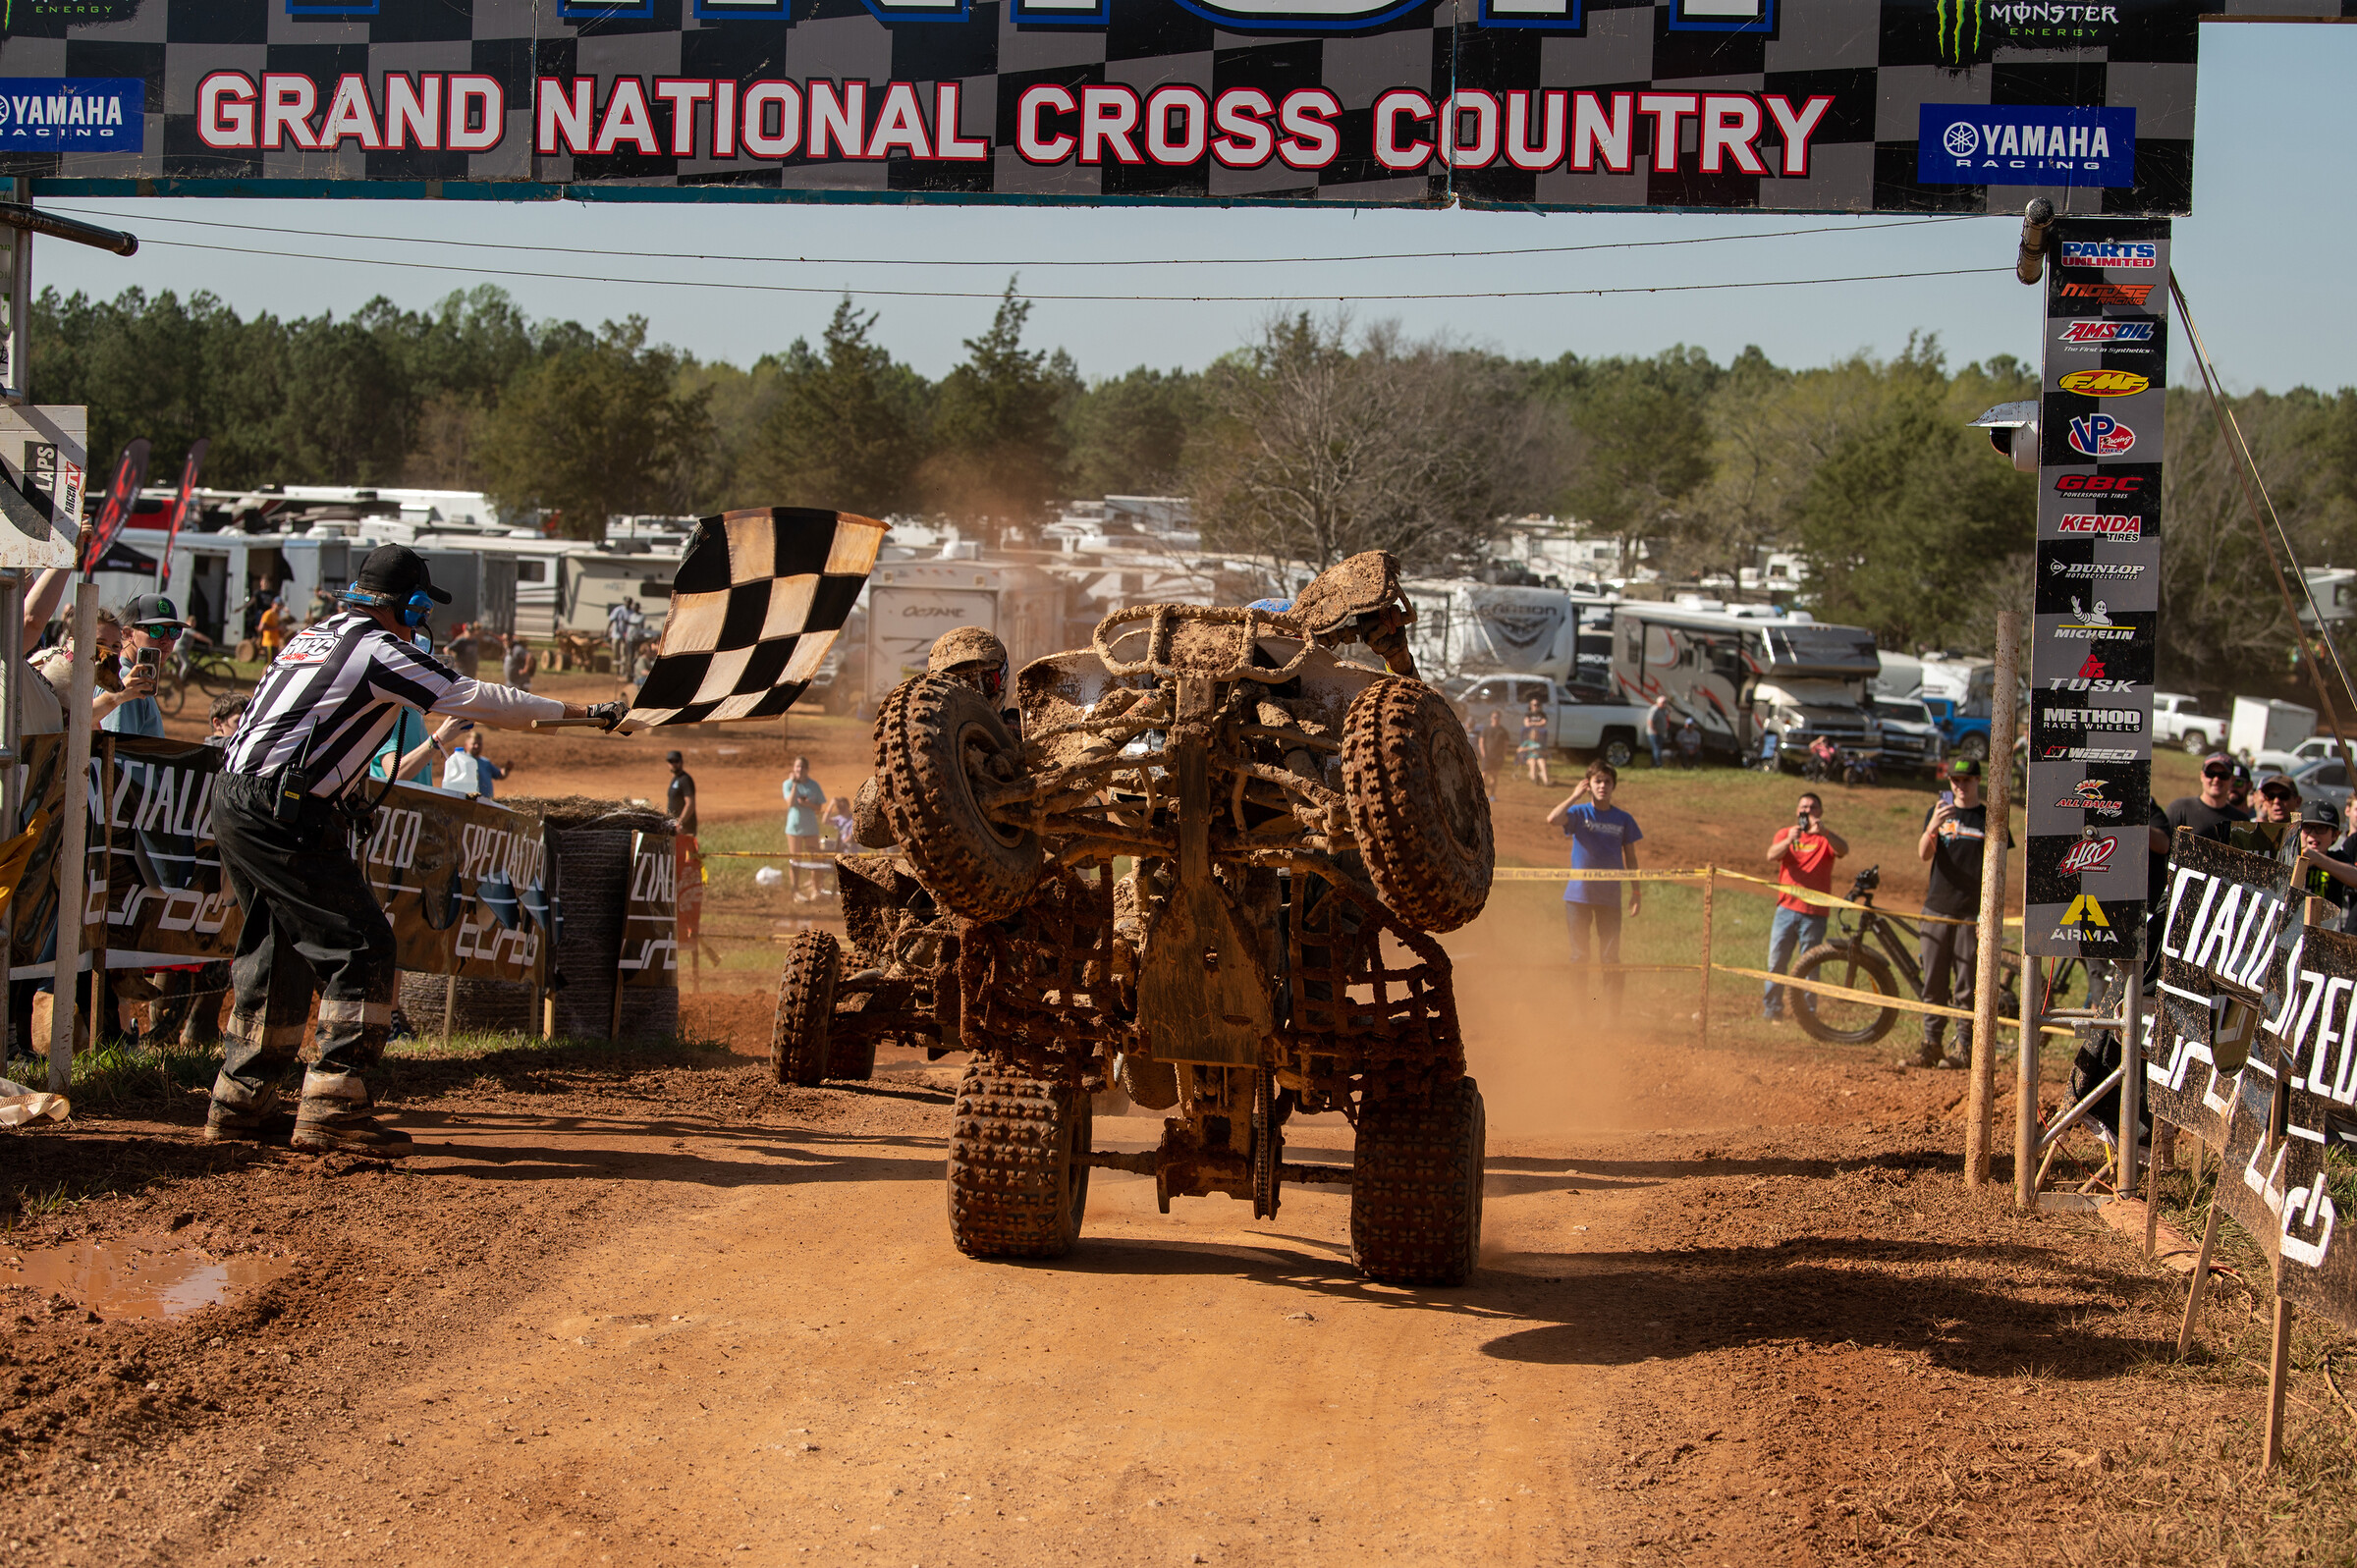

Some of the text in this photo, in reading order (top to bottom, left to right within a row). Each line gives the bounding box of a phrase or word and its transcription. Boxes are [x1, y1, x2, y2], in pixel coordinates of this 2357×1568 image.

[1990, 2, 2118, 25] MONSTER
[2009, 27, 2099, 37] ENERGY
[12, 95, 123, 126] YAMAHA
[197, 72, 1836, 177] GRAND NATIONAL CROSS COUNTRY
[1982, 124, 2110, 158] YAMAHA
[1955, 159, 2100, 170] RACING
[2062, 242, 2155, 258] PARTS
[2062, 256, 2155, 267] UNLIMITED
[2060, 283, 2156, 297] MOOSE
[2060, 322, 2154, 342] AMSOIL
[2059, 373, 2149, 391] FMF
[2069, 413, 2116, 455] VP
[35, 446, 55, 491] LAPS
[2056, 475, 2144, 491] GBC
[2058, 514, 2141, 532] KENDA
[2108, 532, 2139, 542] TIRES
[2067, 563, 2146, 574] DUNLOP
[2054, 628, 2135, 640] MICHELIN
[2050, 677, 2137, 693] TUSK
[2043, 707, 2141, 725] METHOD
[2084, 723, 2140, 731] WHEELS
[2056, 798, 2122, 809] ALL BALLS
[366, 804, 422, 869] ZED
[2050, 928, 2119, 944] ARMA
